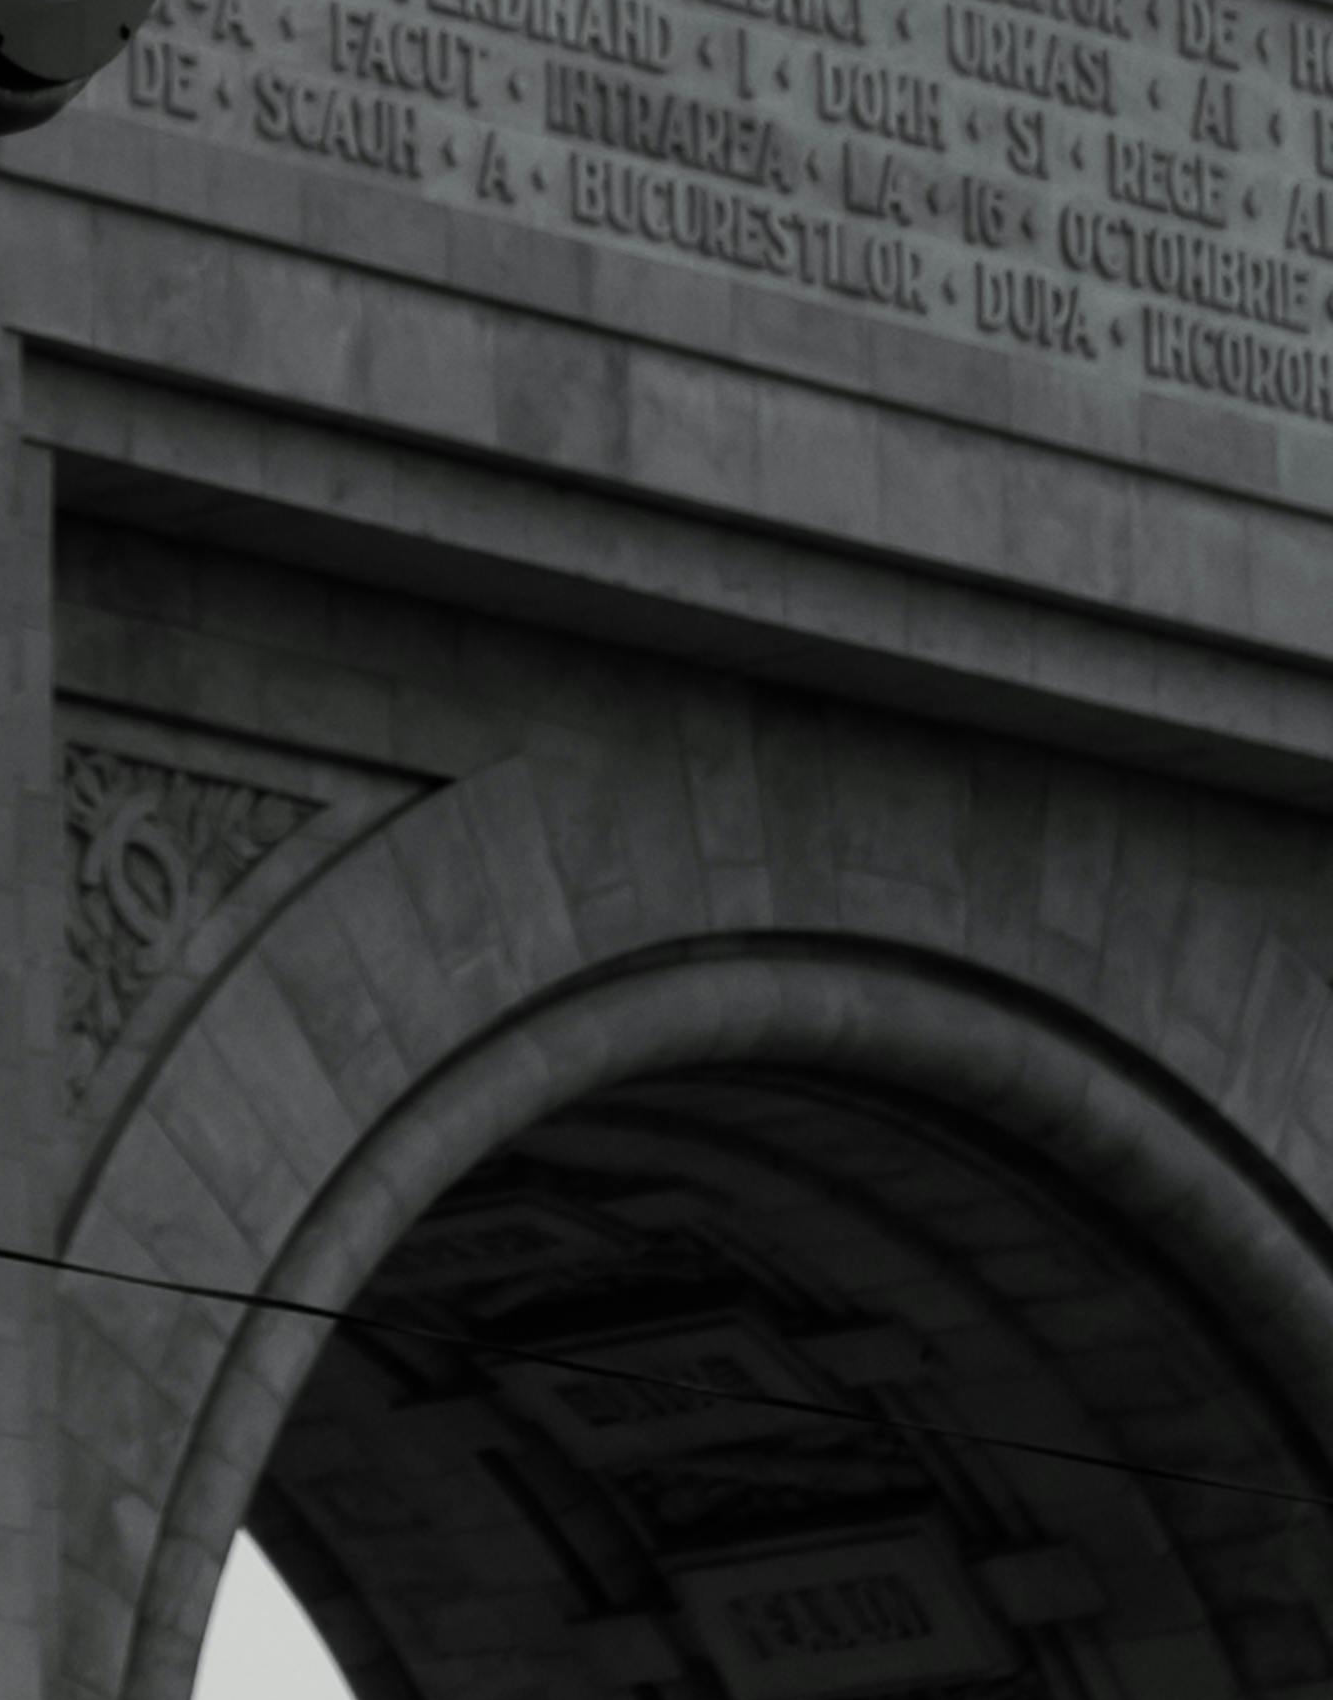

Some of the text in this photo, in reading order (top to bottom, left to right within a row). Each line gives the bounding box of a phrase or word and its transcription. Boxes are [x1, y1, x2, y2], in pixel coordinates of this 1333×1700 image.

[128, 38, 198, 122] DE
[476, 130, 515, 203] A
[974, 260, 1098, 359] DUPA
[329, 0, 488, 109] FACUT
[842, 140, 912, 227] LA
[962, 176, 1007, 248] 16
[1058, 206, 1312, 333] OCTOMBRIE
[736, 27, 753, 100] I
[1005, 107, 1049, 181] SI
[1106, 133, 1228, 229] REGE
[1190, 77, 1239, 151] AI
